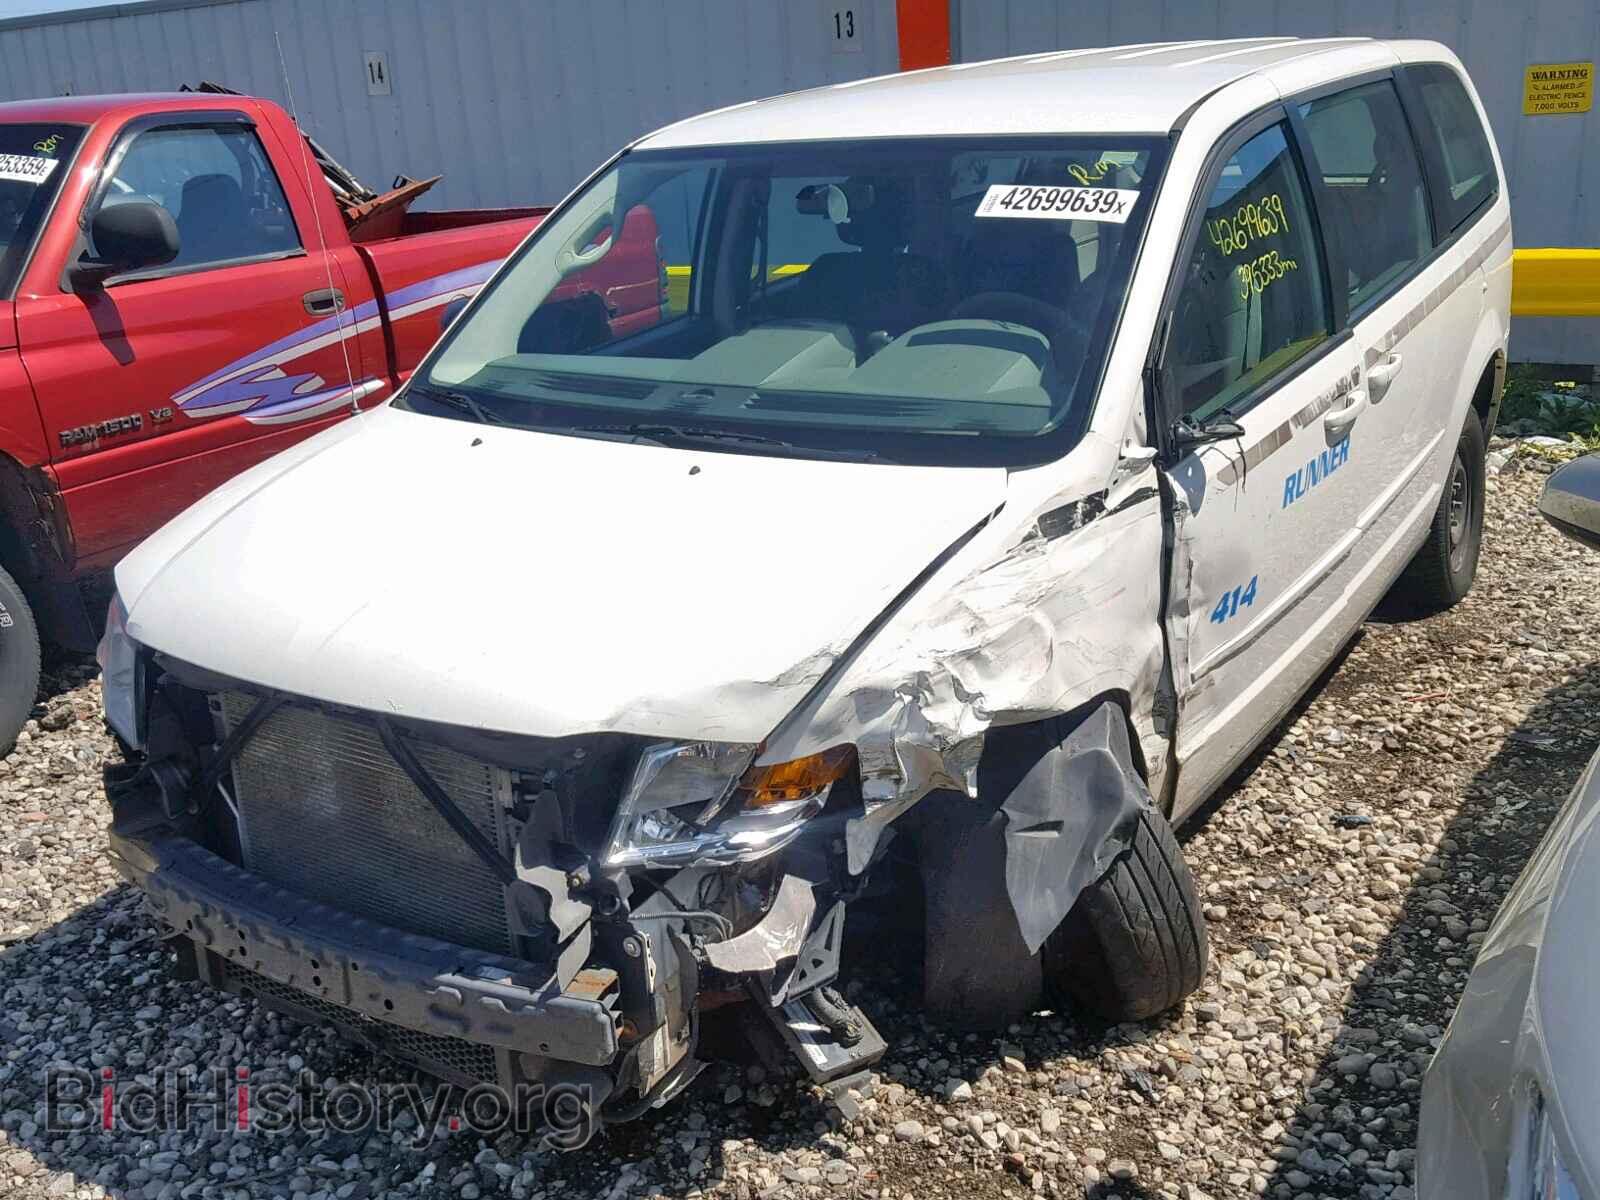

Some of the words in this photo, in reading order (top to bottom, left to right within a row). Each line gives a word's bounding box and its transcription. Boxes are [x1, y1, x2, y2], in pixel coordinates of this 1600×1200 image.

[833, 10, 854, 39] 13
[368, 61, 384, 84] 14
[1531, 70, 1588, 80] WARNING
[1542, 83, 1576, 91] ALARMED
[1557, 102, 1580, 110] VOLTS
[1207, 194, 1288, 256] 42699639
[59, 424, 99, 447] RAM
[103, 413, 142, 436] 1500
[1281, 434, 1351, 509] RUNNER
[1210, 575, 1258, 625] 414
